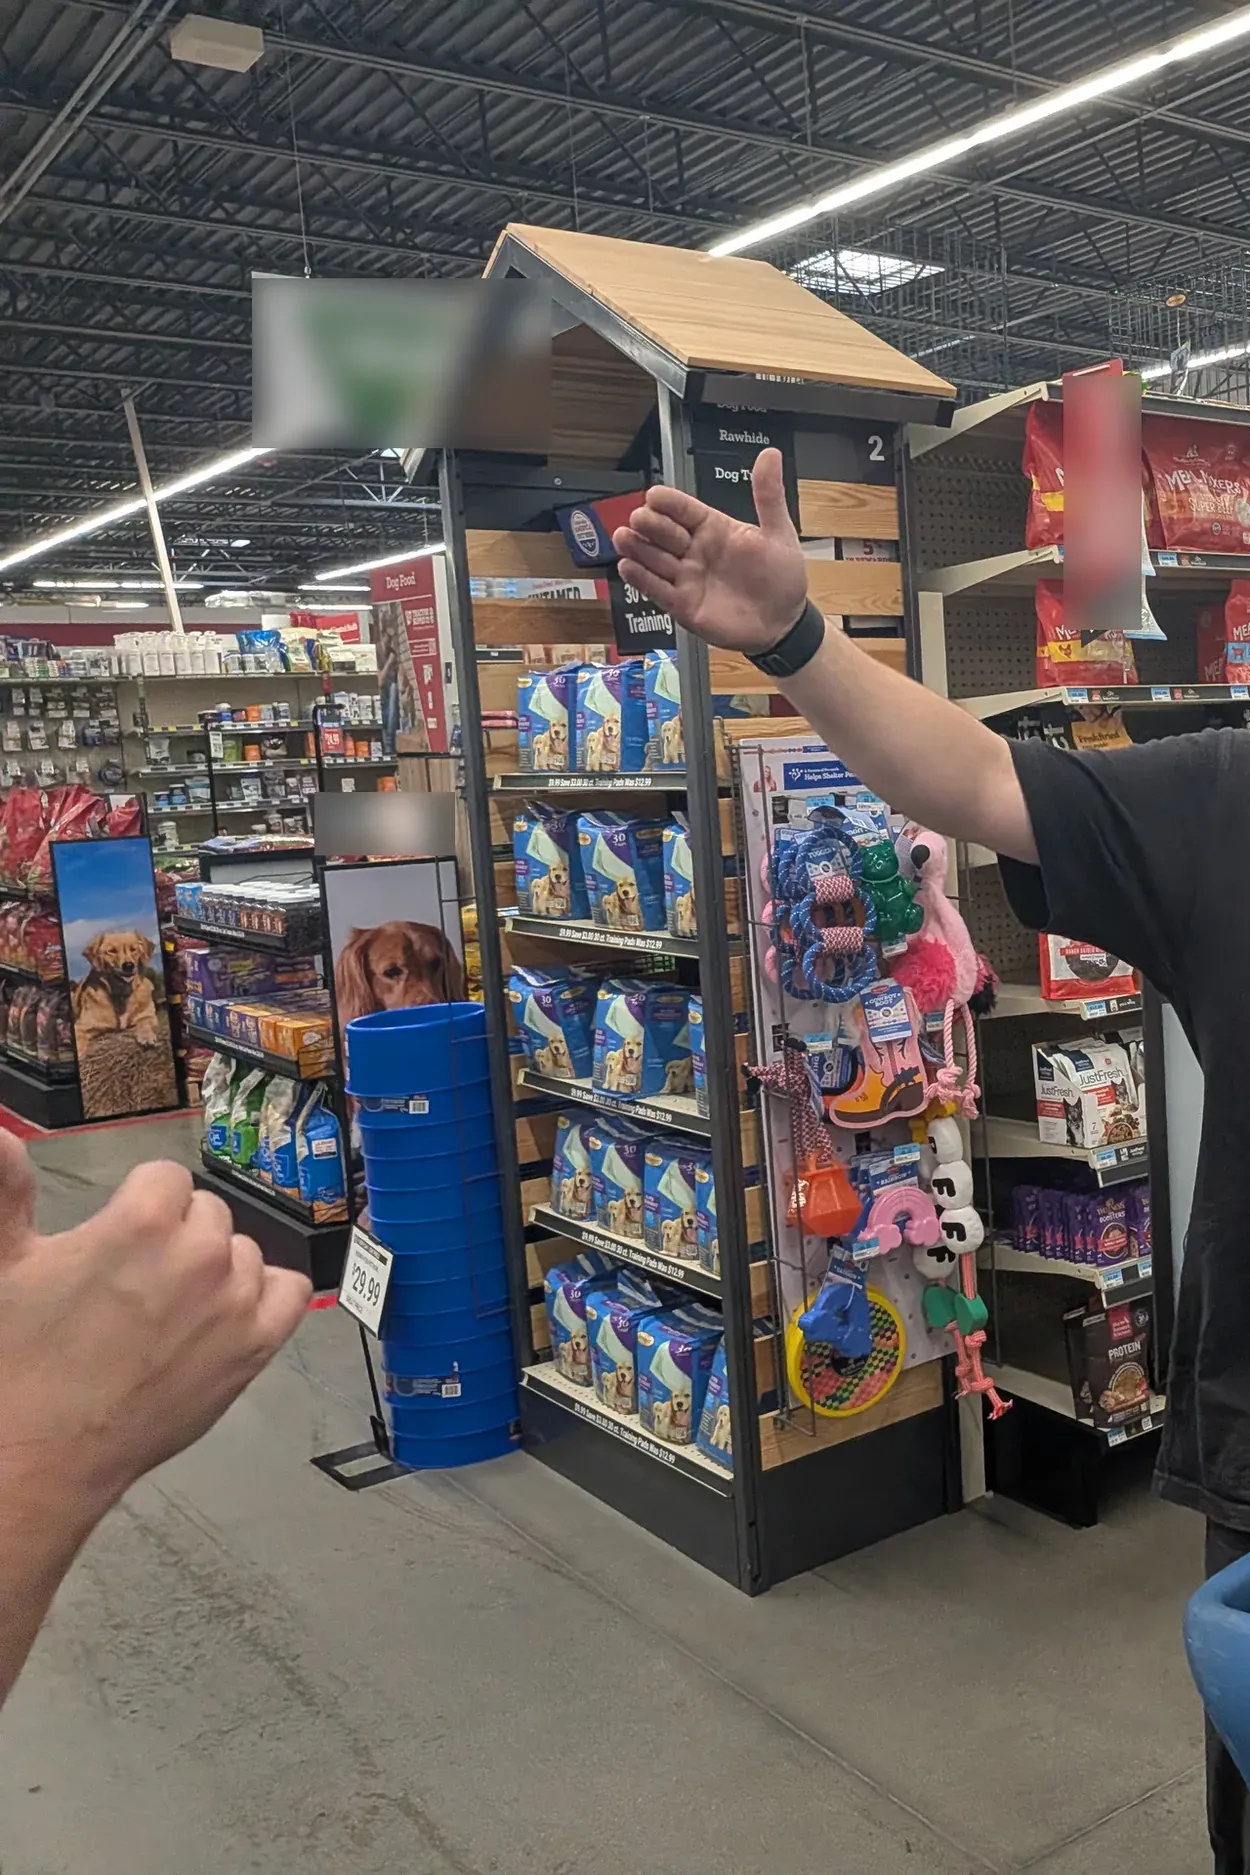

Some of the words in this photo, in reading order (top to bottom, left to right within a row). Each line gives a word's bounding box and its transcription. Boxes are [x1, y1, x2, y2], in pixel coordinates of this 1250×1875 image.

[719, 429, 770, 445] Rawhide
[868, 435, 886, 462] 2
[715, 467, 740, 483] Dog
[385, 577, 399, 591] Dog
[399, 571, 416, 587] Food
[624, 583, 639, 604] 30
[625, 610, 673, 635] Training
[804, 772, 822, 782] Helps
[823, 771, 844, 780] Shelter
[612, 834, 626, 844] 30
[572, 930, 582, 939] Save
[606, 934, 624, 946] Training
[623, 936, 635, 946] Pads
[646, 938, 662, 949] $12.99
[541, 995, 552, 1004] 30
[868, 993, 898, 1004] COWBOY
[874, 999, 893, 1008] BOOT
[1079, 1067, 1125, 1086] JustFresh
[1040, 1086, 1074, 1098] JustFresh
[582, 1091, 594, 1100] Save
[636, 1104, 646, 1115] Pads
[656, 1110, 672, 1122] $12.99
[624, 1144, 637, 1156] 30
[582, 1231, 594, 1243] $9.99
[594, 1235, 604, 1246] Save
[629, 1249, 647, 1266] Training
[646, 1255, 658, 1269] Pads
[658, 1260, 668, 1273] Was
[668, 1264, 684, 1279] $12.99
[352, 1262, 380, 1307] $29.99
[569, 1289, 581, 1299] 30
[1108, 1341, 1141, 1361] PROTEIN
[586, 1408, 596, 1421] Save
[619, 1427, 638, 1446] Training
[638, 1436, 649, 1450] Pads
[659, 1448, 676, 1464] $12.99
